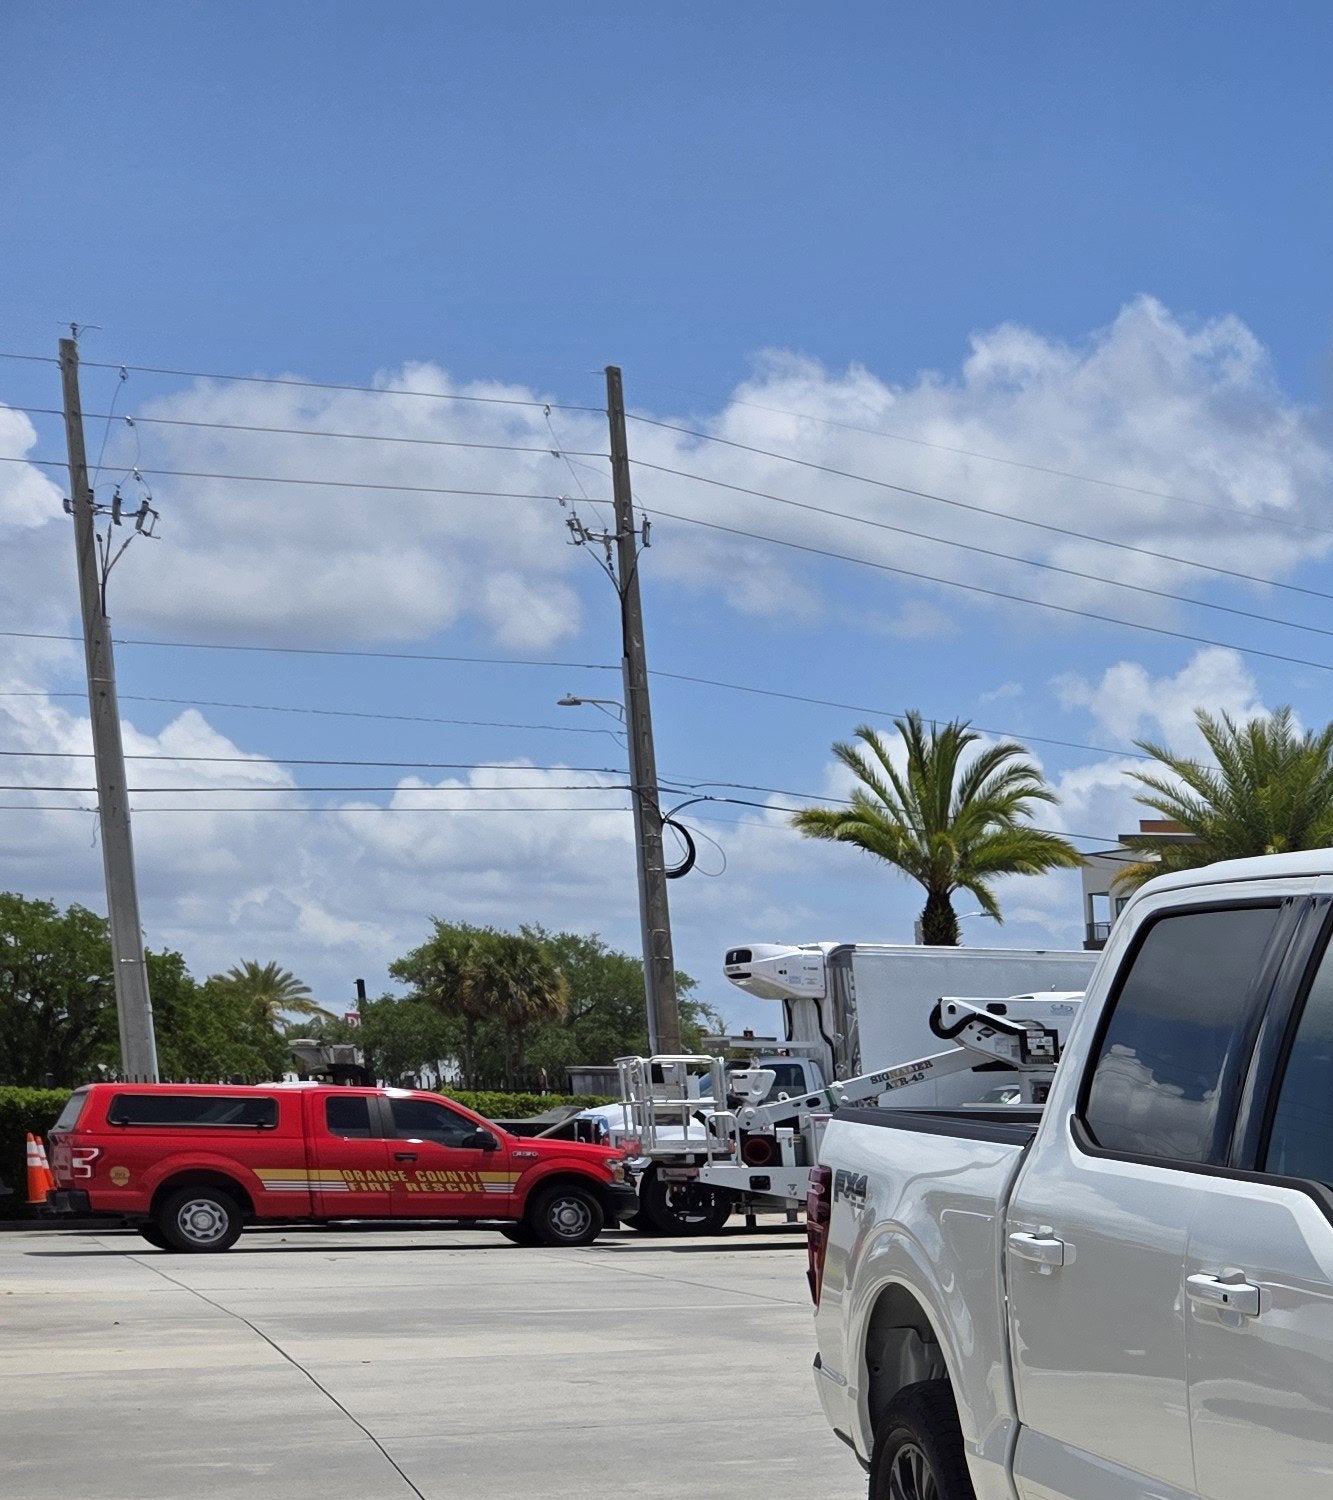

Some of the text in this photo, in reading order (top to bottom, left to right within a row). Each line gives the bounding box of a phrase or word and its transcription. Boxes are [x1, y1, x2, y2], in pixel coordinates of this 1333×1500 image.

[342, 1169, 479, 1183] ORANGE COUNTY
[349, 1182, 485, 1193] FIRE RESCUE
[834, 1169, 868, 1203] FX4
